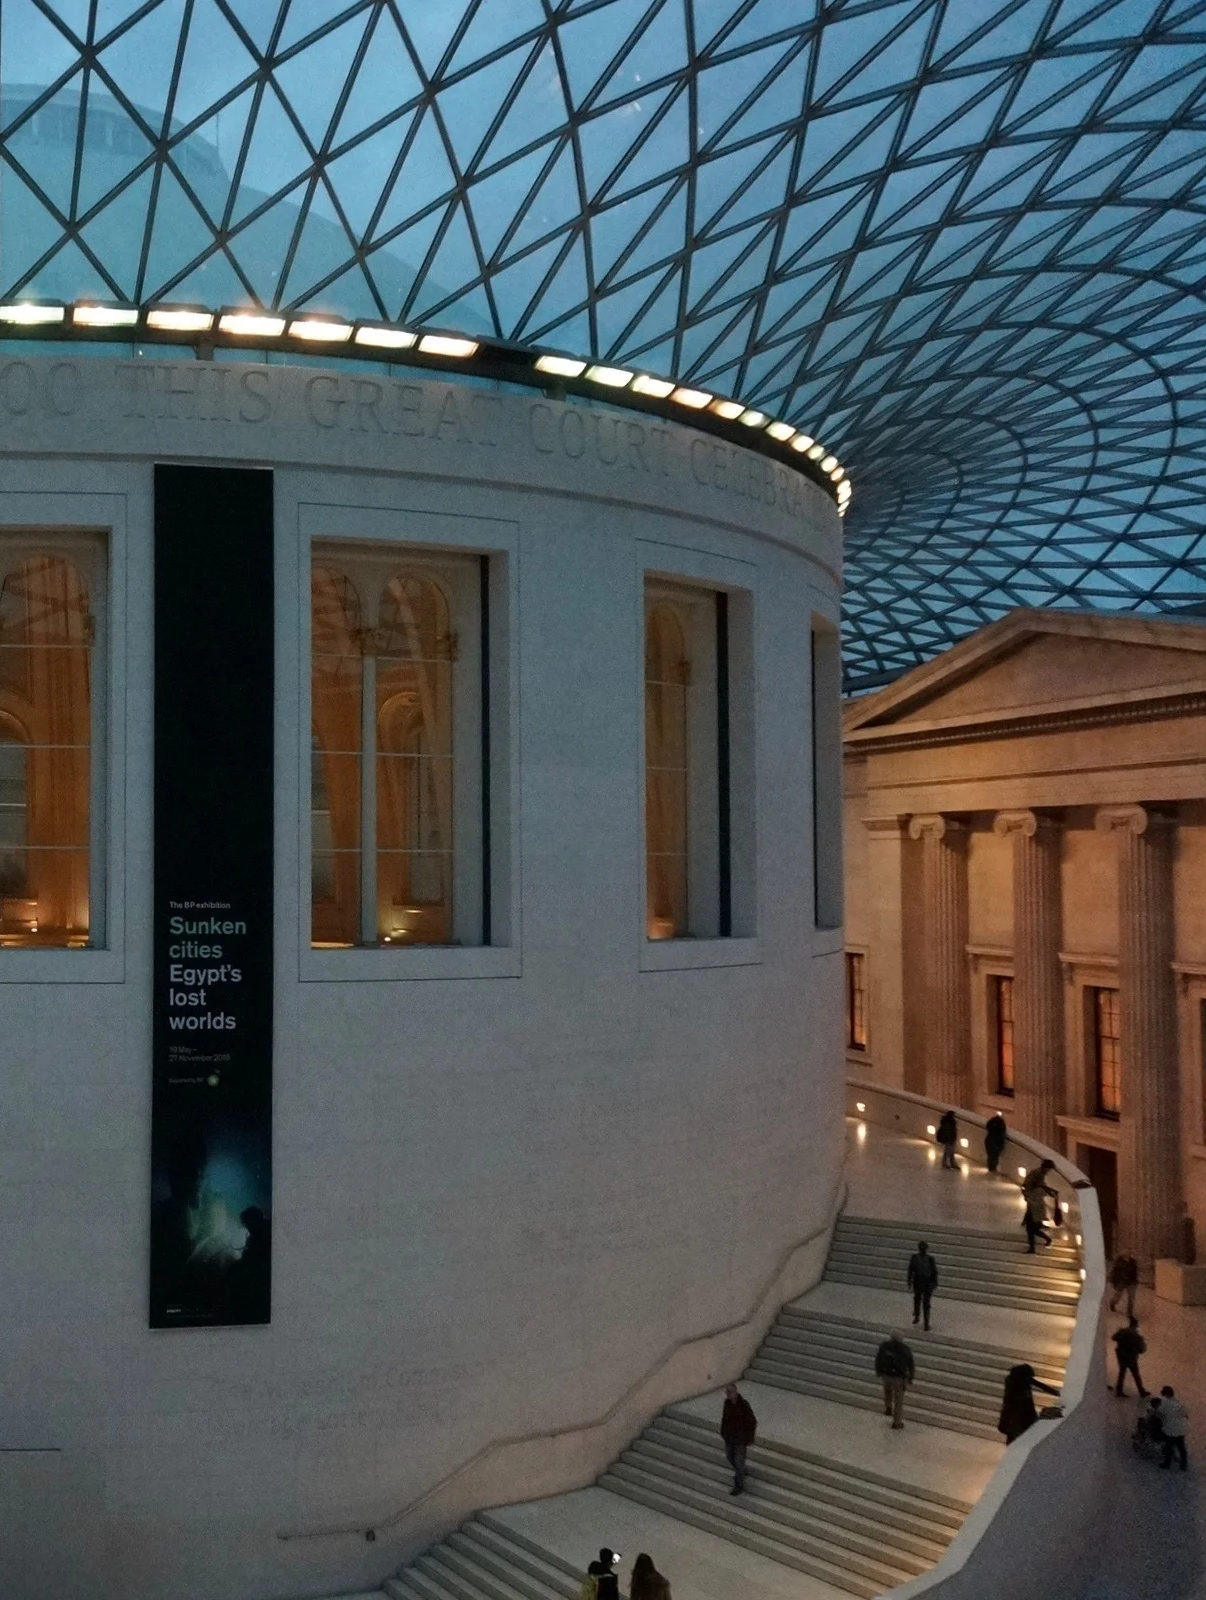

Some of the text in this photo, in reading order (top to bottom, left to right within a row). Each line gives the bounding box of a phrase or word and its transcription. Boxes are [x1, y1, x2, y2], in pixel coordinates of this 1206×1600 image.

[114, 364, 272, 424] THIS
[304, 375, 505, 447] GREAT
[529, 402, 676, 478] COURT
[169, 901, 231, 909] The BP exhibition
[169, 916, 247, 935] Sunken
[169, 940, 223, 959] cities
[169, 988, 207, 1007] lost
[168, 1011, 237, 1030] worlds
